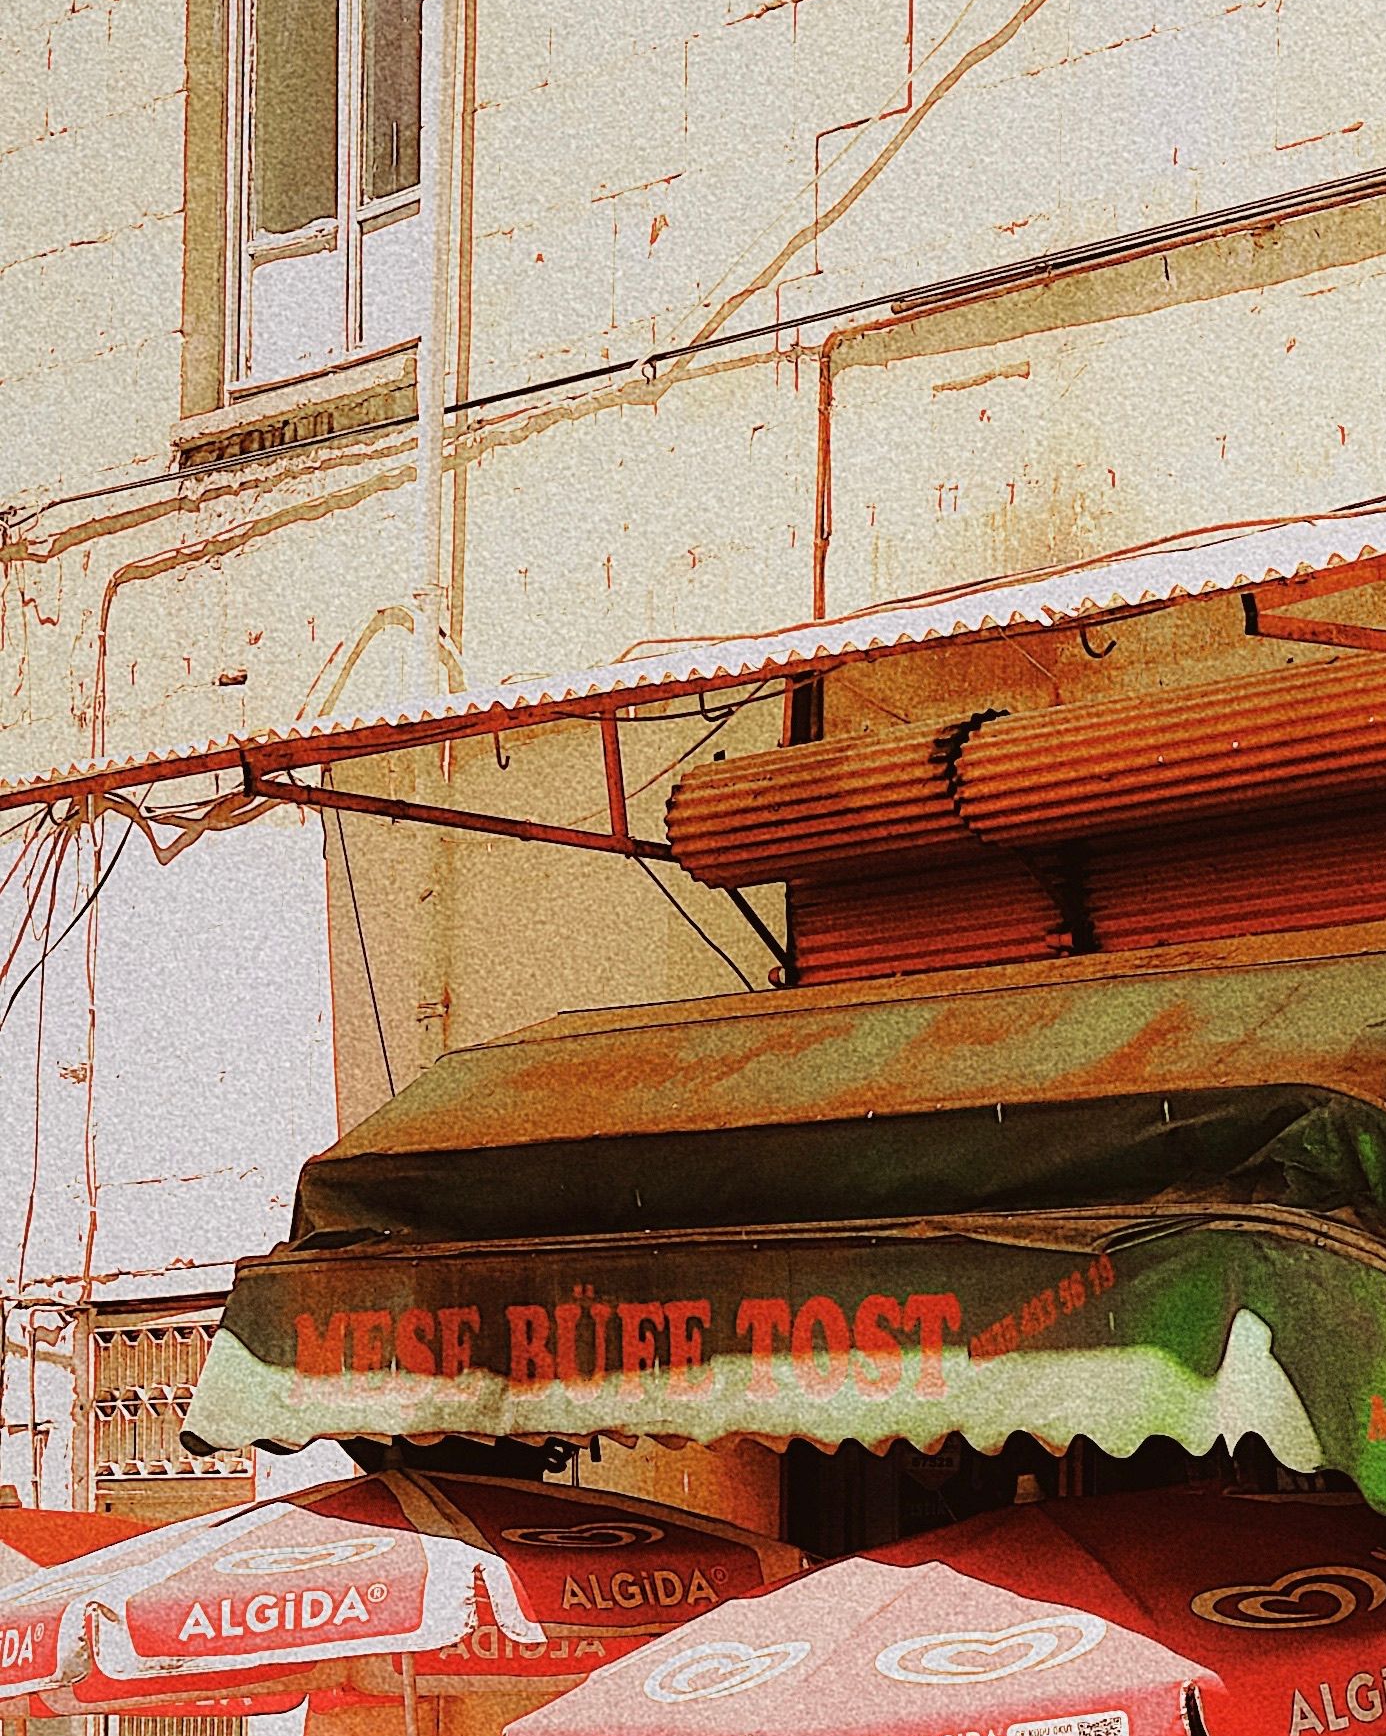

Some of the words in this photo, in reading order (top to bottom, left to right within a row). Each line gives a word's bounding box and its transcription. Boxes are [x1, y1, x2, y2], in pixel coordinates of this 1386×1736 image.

[290, 1306, 482, 1418] MEŞE
[505, 1285, 712, 1404] BÜFE
[736, 1293, 963, 1401] TOST
